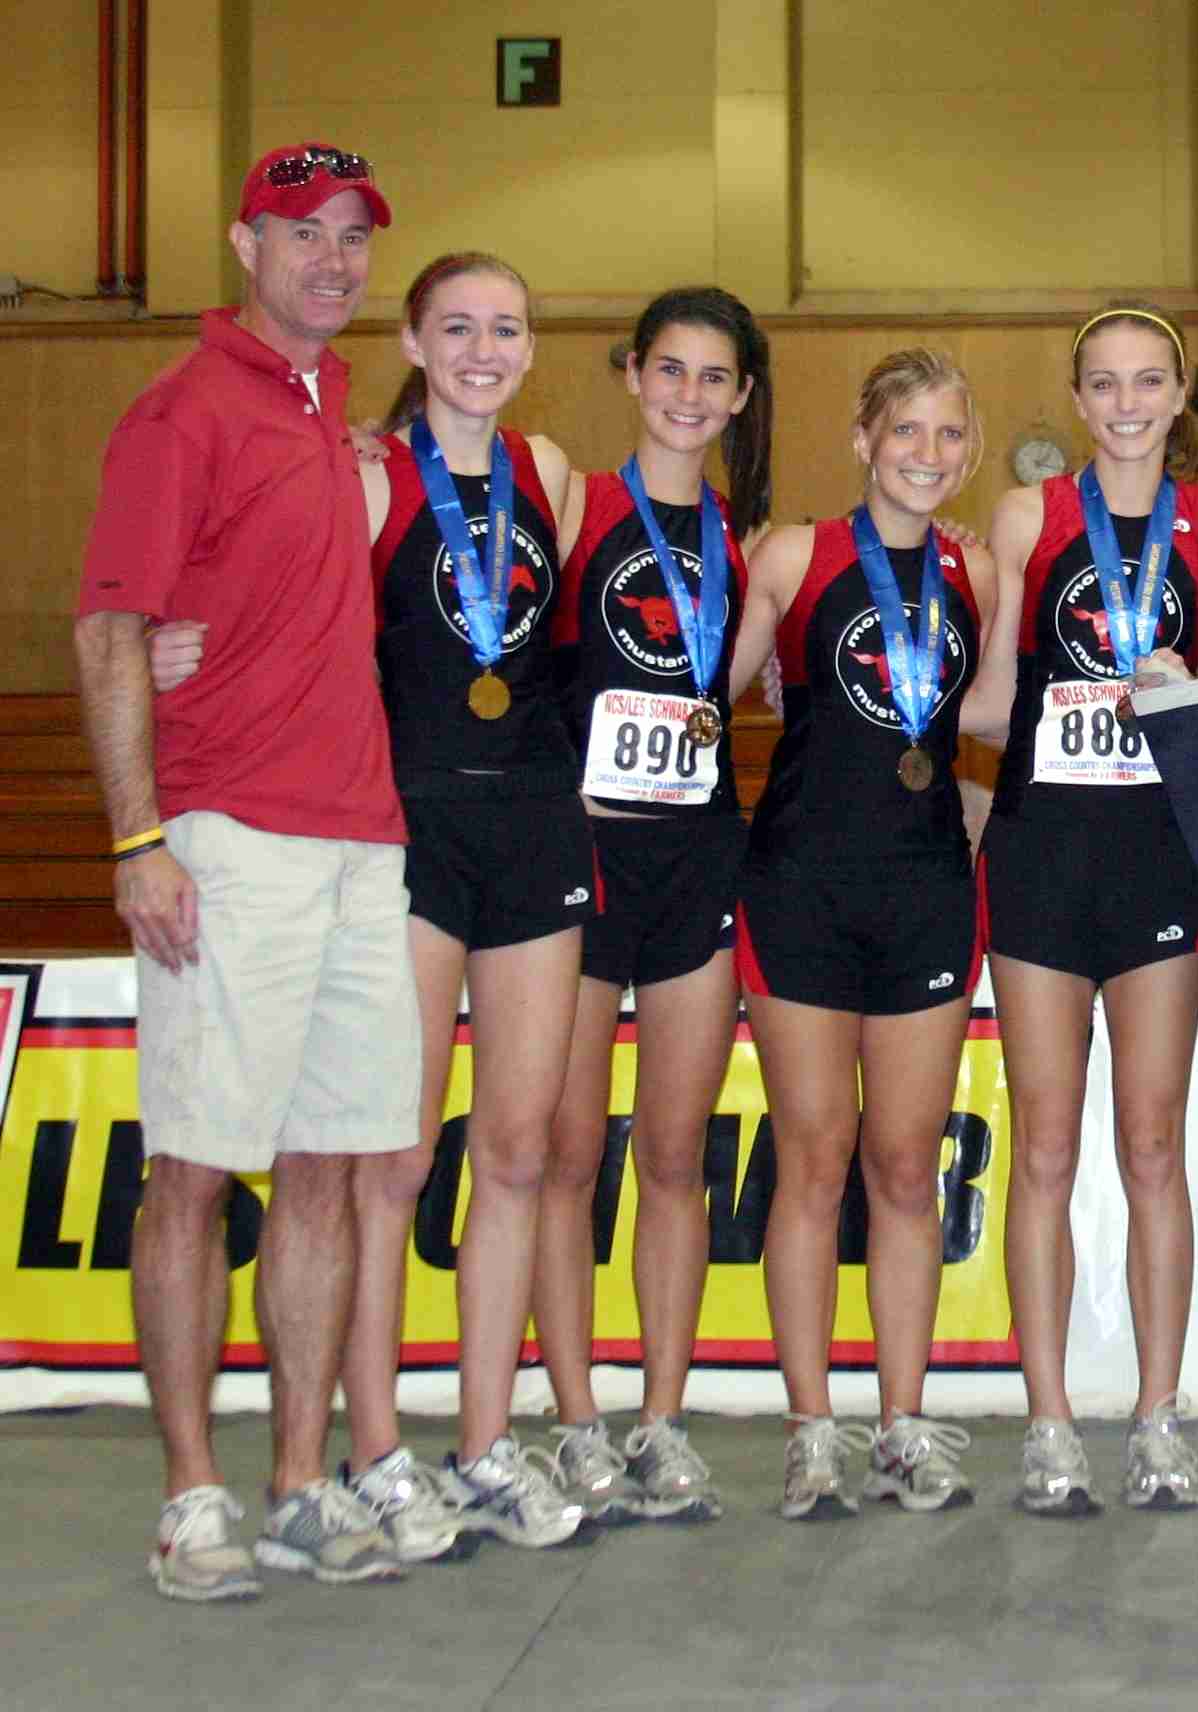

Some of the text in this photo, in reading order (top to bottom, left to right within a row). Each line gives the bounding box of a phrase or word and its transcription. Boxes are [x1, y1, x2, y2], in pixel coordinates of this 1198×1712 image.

[504, 42, 550, 101] F
[614, 722, 697, 777] 890
[1061, 708, 1142, 758] 888
